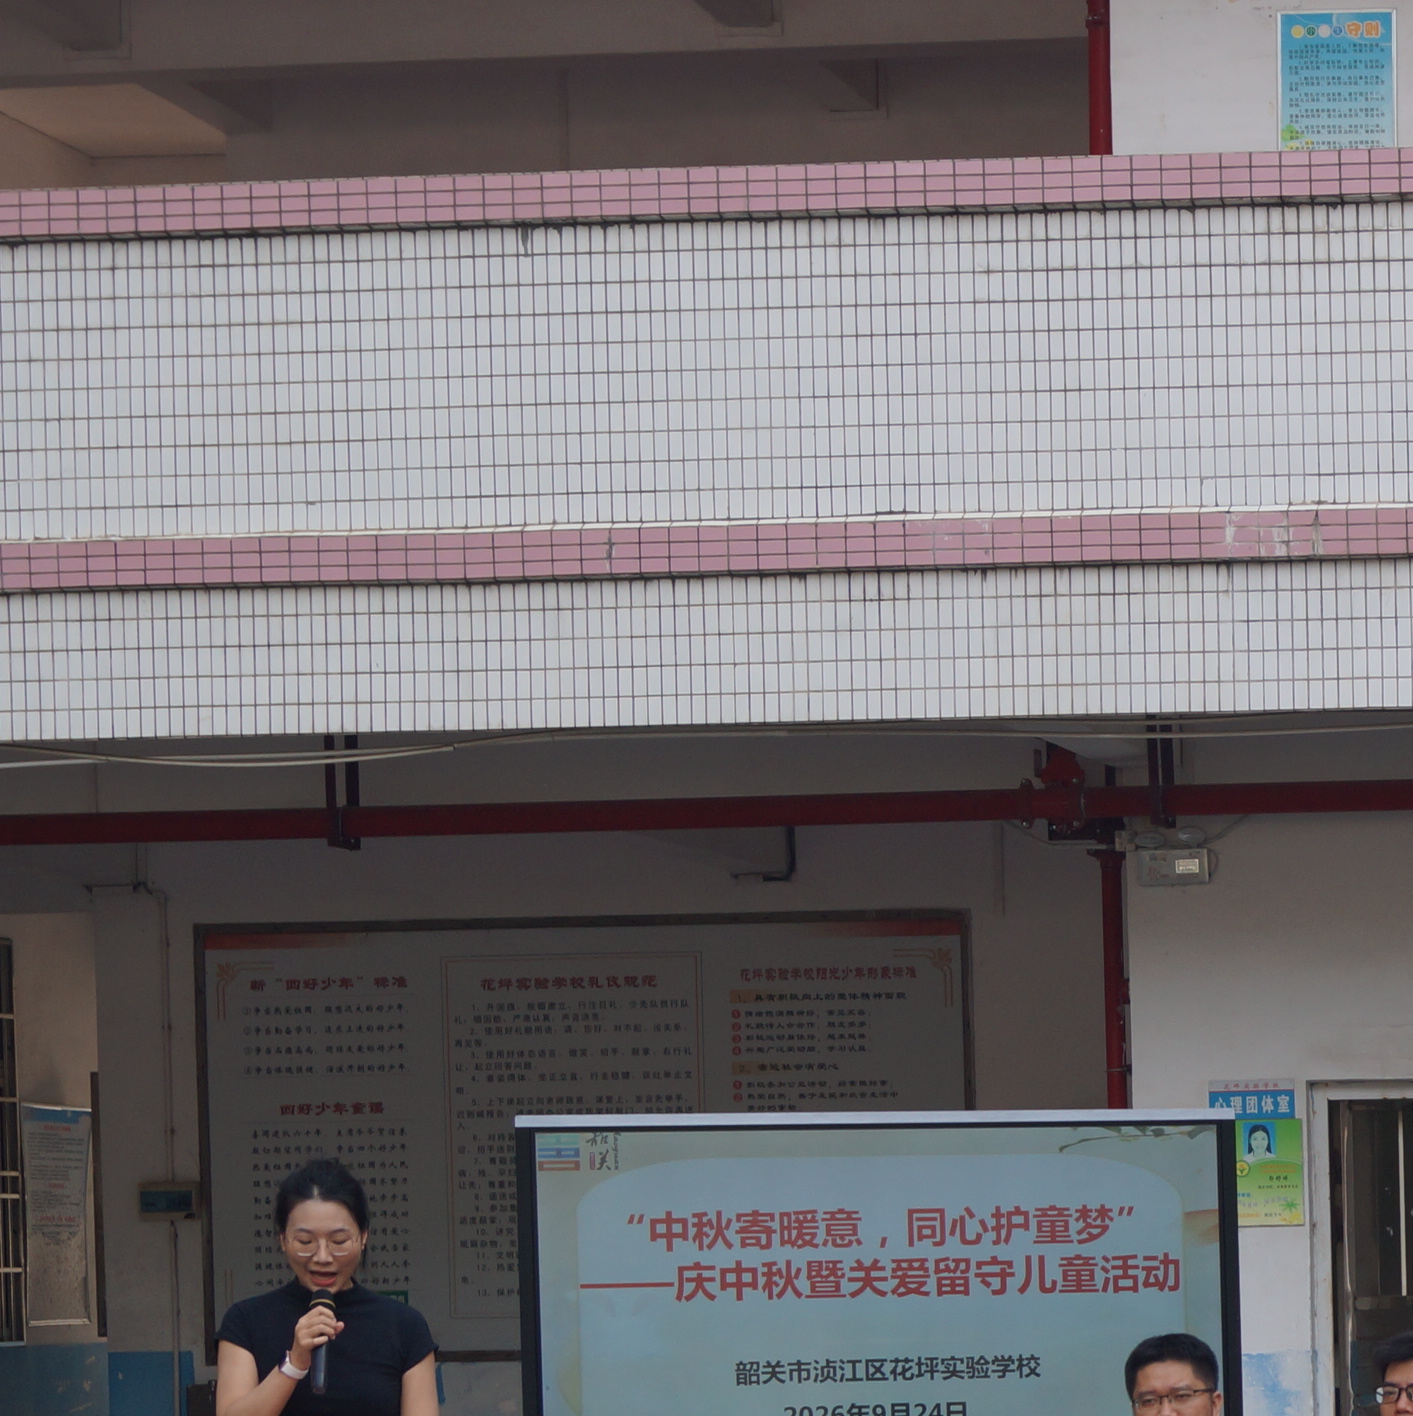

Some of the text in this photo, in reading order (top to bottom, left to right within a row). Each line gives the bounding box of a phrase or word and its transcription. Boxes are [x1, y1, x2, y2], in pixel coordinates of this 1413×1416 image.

[481, 974, 658, 991] 花坪实验学校礼仪规范
[1214, 1094, 1291, 1114] 心理团体室
[627, 1205, 1136, 1253] “中秋寄暖意，同心护童梦”
[735, 1353, 1042, 1389] 韶关市浈江区花坪实验学校
